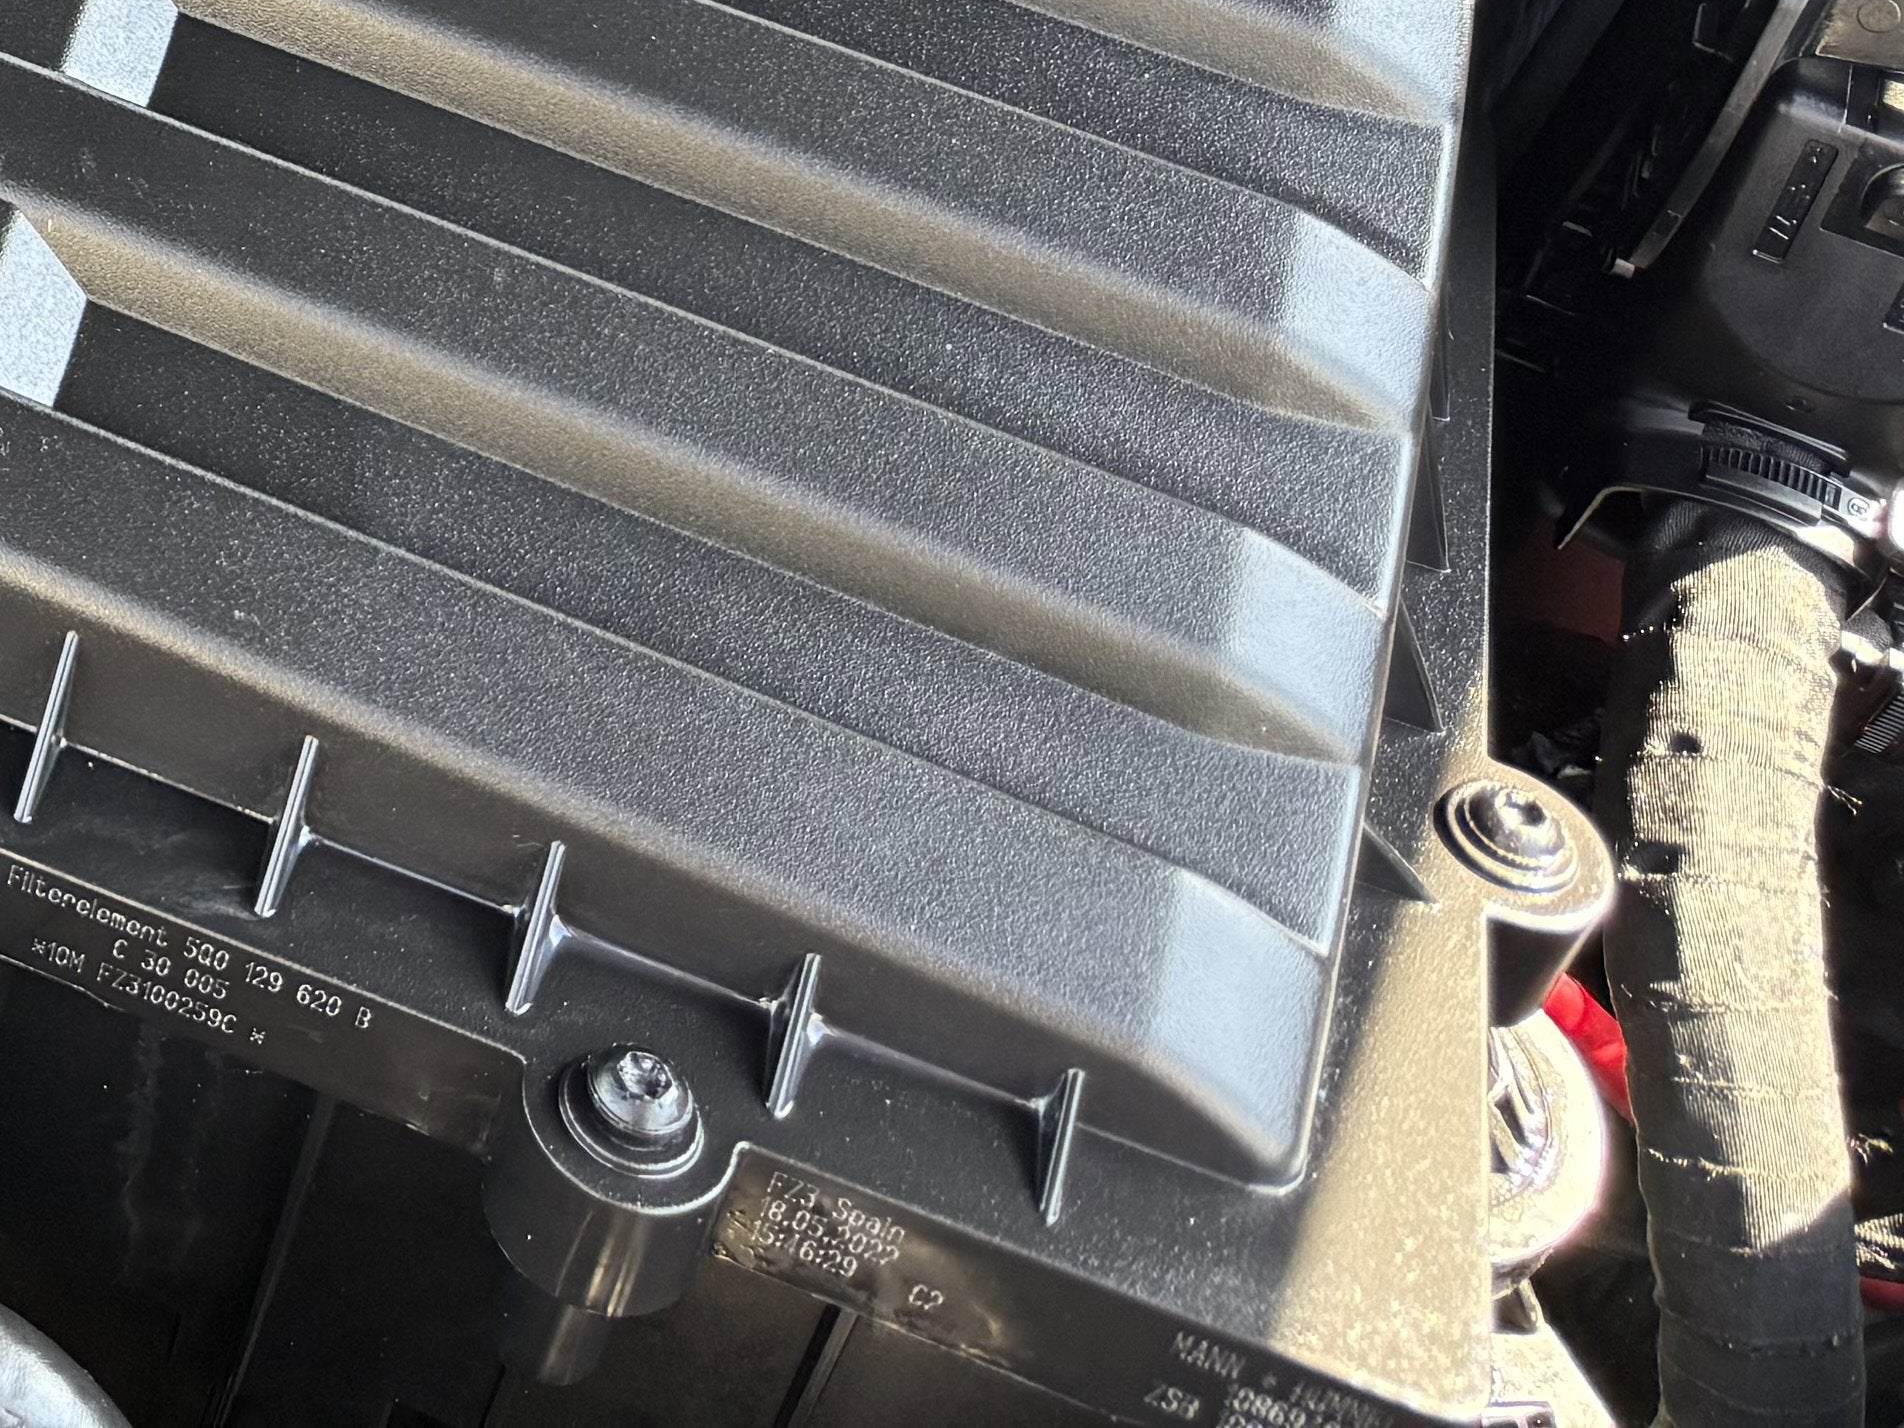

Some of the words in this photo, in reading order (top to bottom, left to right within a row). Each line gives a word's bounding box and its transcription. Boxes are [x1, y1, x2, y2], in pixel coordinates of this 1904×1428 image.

[6, 864, 168, 948] Filterelement
[244, 961, 284, 993] 129
[296, 984, 343, 1018] 620
[354, 1006, 373, 1030] B
[112, 938, 128, 960] C
[140, 949, 172, 977] 30
[183, 968, 231, 1001] 005
[759, 1195, 901, 1267] 18.05.2022
[765, 1170, 821, 1210] FZ3
[831, 1197, 907, 1245] Spain
[908, 1283, 944, 1311] C2
